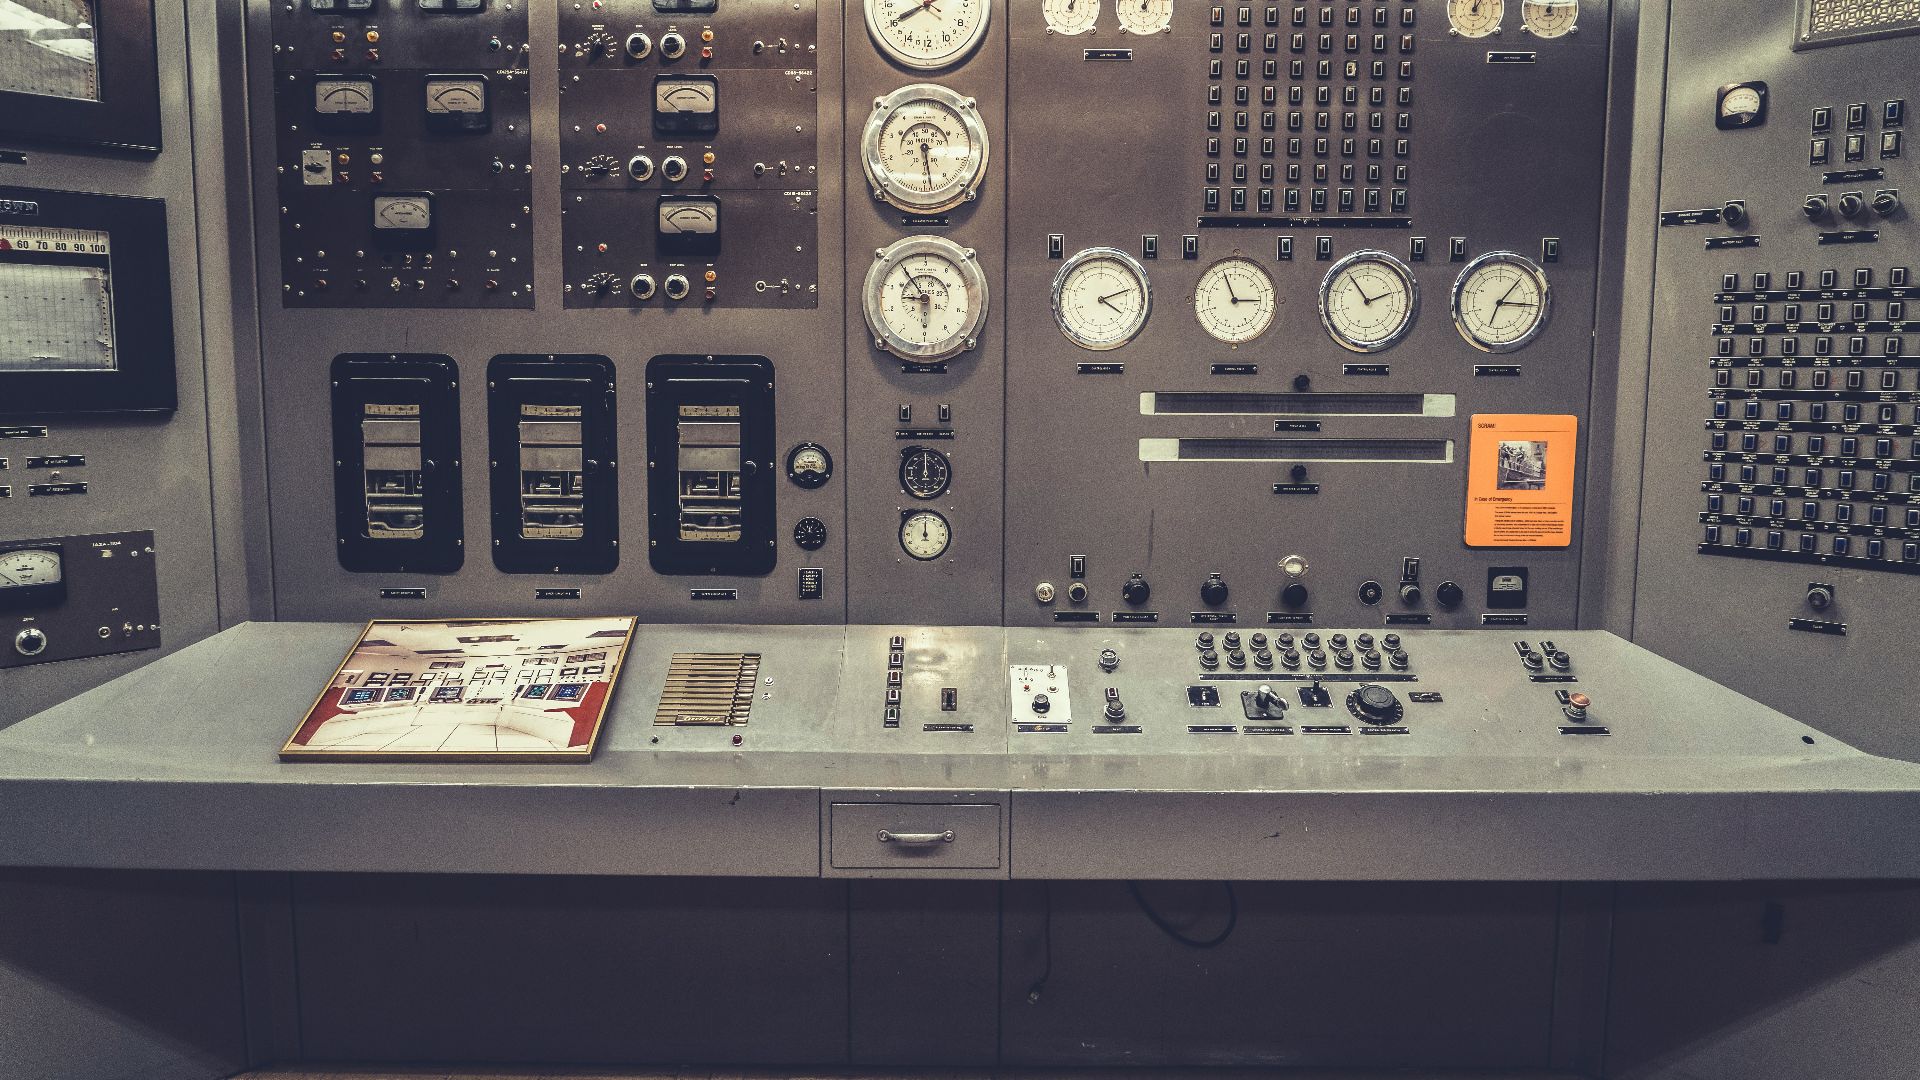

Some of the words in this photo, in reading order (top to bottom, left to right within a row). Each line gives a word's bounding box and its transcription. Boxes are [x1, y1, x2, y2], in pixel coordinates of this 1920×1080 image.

[890, 19, 898, 28] 16
[957, 19, 964, 27] 8
[904, 34, 913, 43] 14
[942, 34, 951, 43] 10
[923, 39, 932, 48] 12
[17, 240, 29, 249] 60
[36, 241, 48, 250] 70
[55, 242, 67, 251] 80
[74, 243, 86, 252] 90
[90, 244, 106, 253] 100
